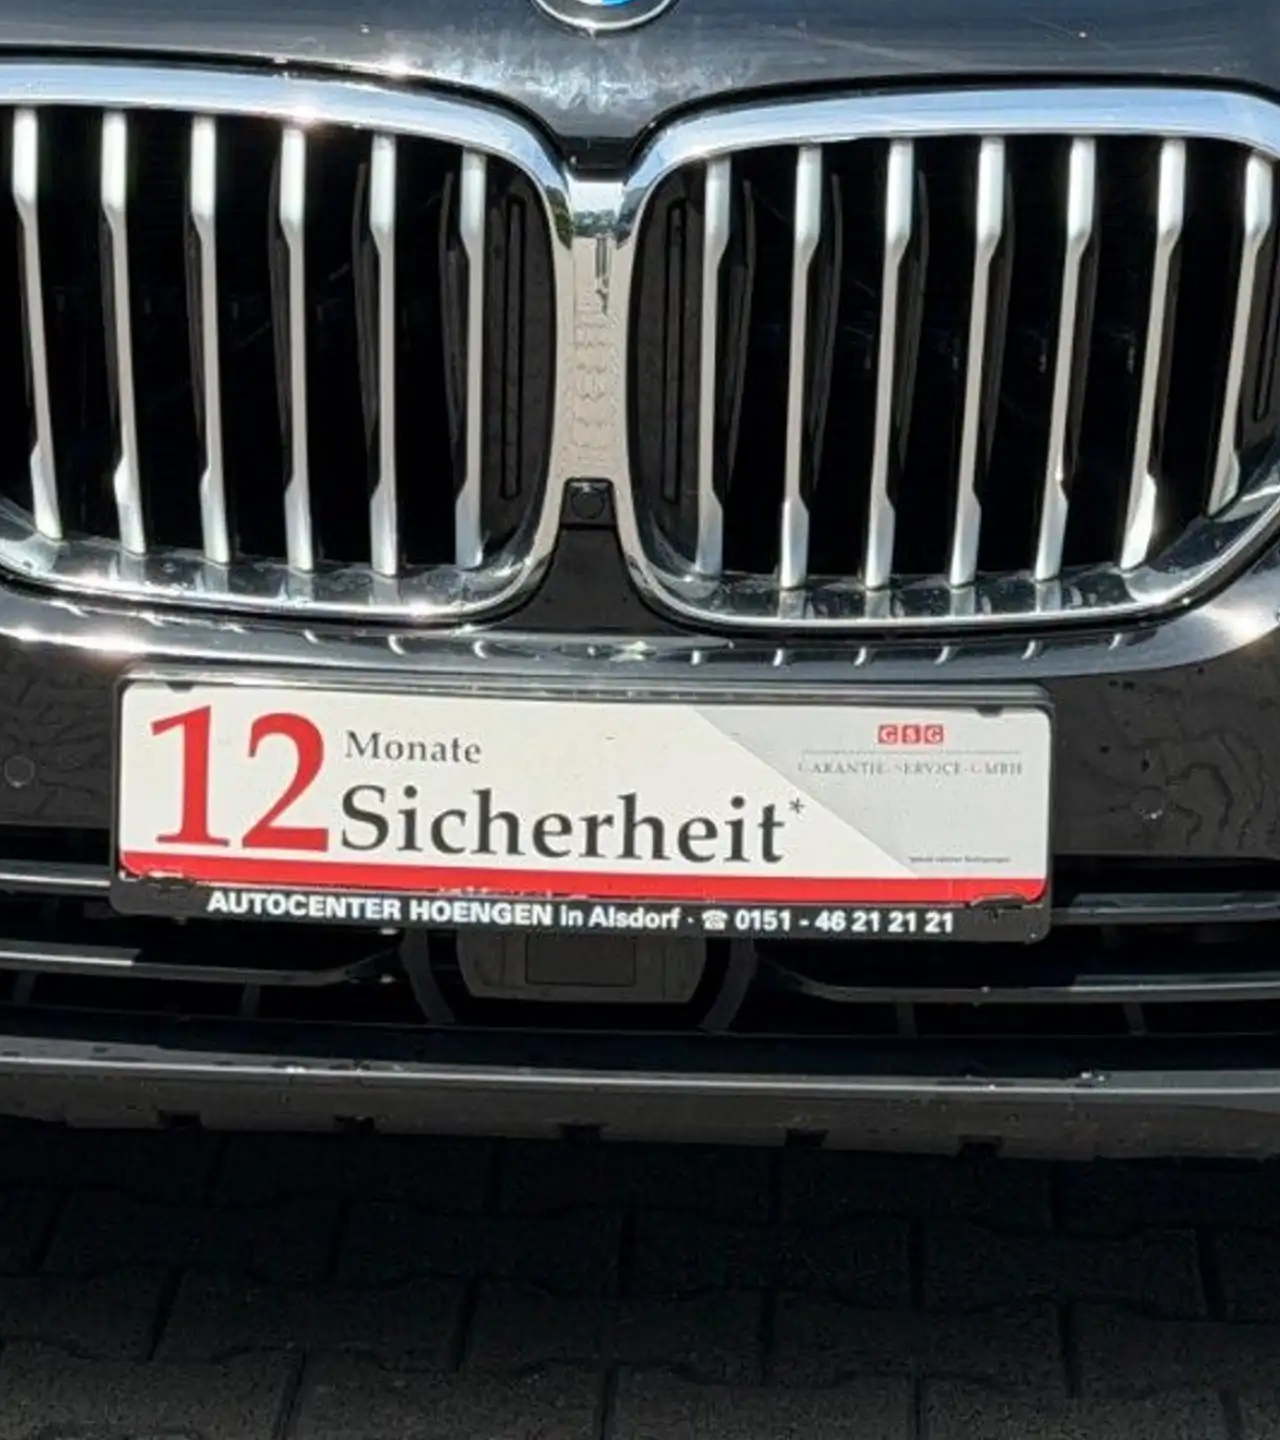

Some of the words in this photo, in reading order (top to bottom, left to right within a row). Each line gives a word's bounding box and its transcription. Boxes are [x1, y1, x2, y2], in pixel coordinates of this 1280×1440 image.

[344, 729, 482, 765] Monate
[877, 724, 945, 745] GSG
[150, 704, 329, 852] 12
[205, 890, 402, 921] AUTOCENTER
[410, 898, 553, 927] HOENGEN
[560, 904, 584, 927] in
[588, 905, 684, 929] Alsdorf
[734, 909, 792, 932] 0151
[814, 909, 846, 933] 46
[850, 910, 880, 933] 21
[887, 910, 917, 934] 21
[924, 911, 954, 934] 21
